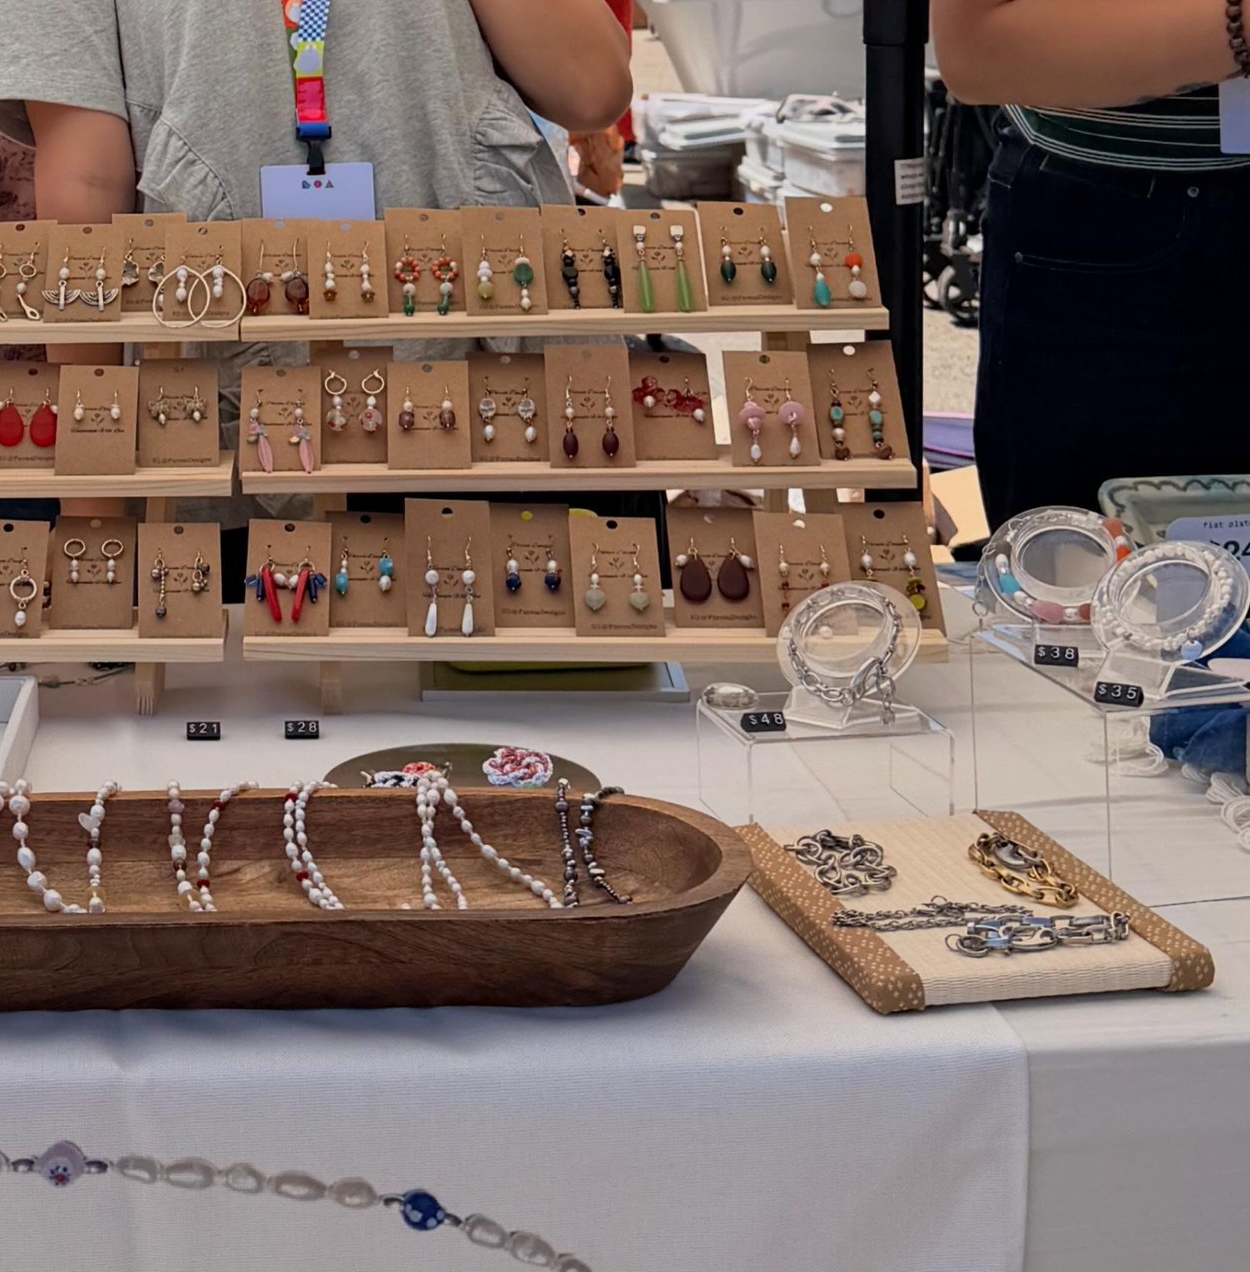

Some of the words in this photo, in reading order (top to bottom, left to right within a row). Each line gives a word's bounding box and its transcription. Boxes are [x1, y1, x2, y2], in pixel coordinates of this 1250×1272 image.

[1228, 519, 1250, 528] plat
[1037, 647, 1075, 660] $38
[1098, 684, 1137, 699] $35
[749, 712, 784, 725] $48
[189, 722, 218, 734] $21
[287, 721, 317, 733] $28
